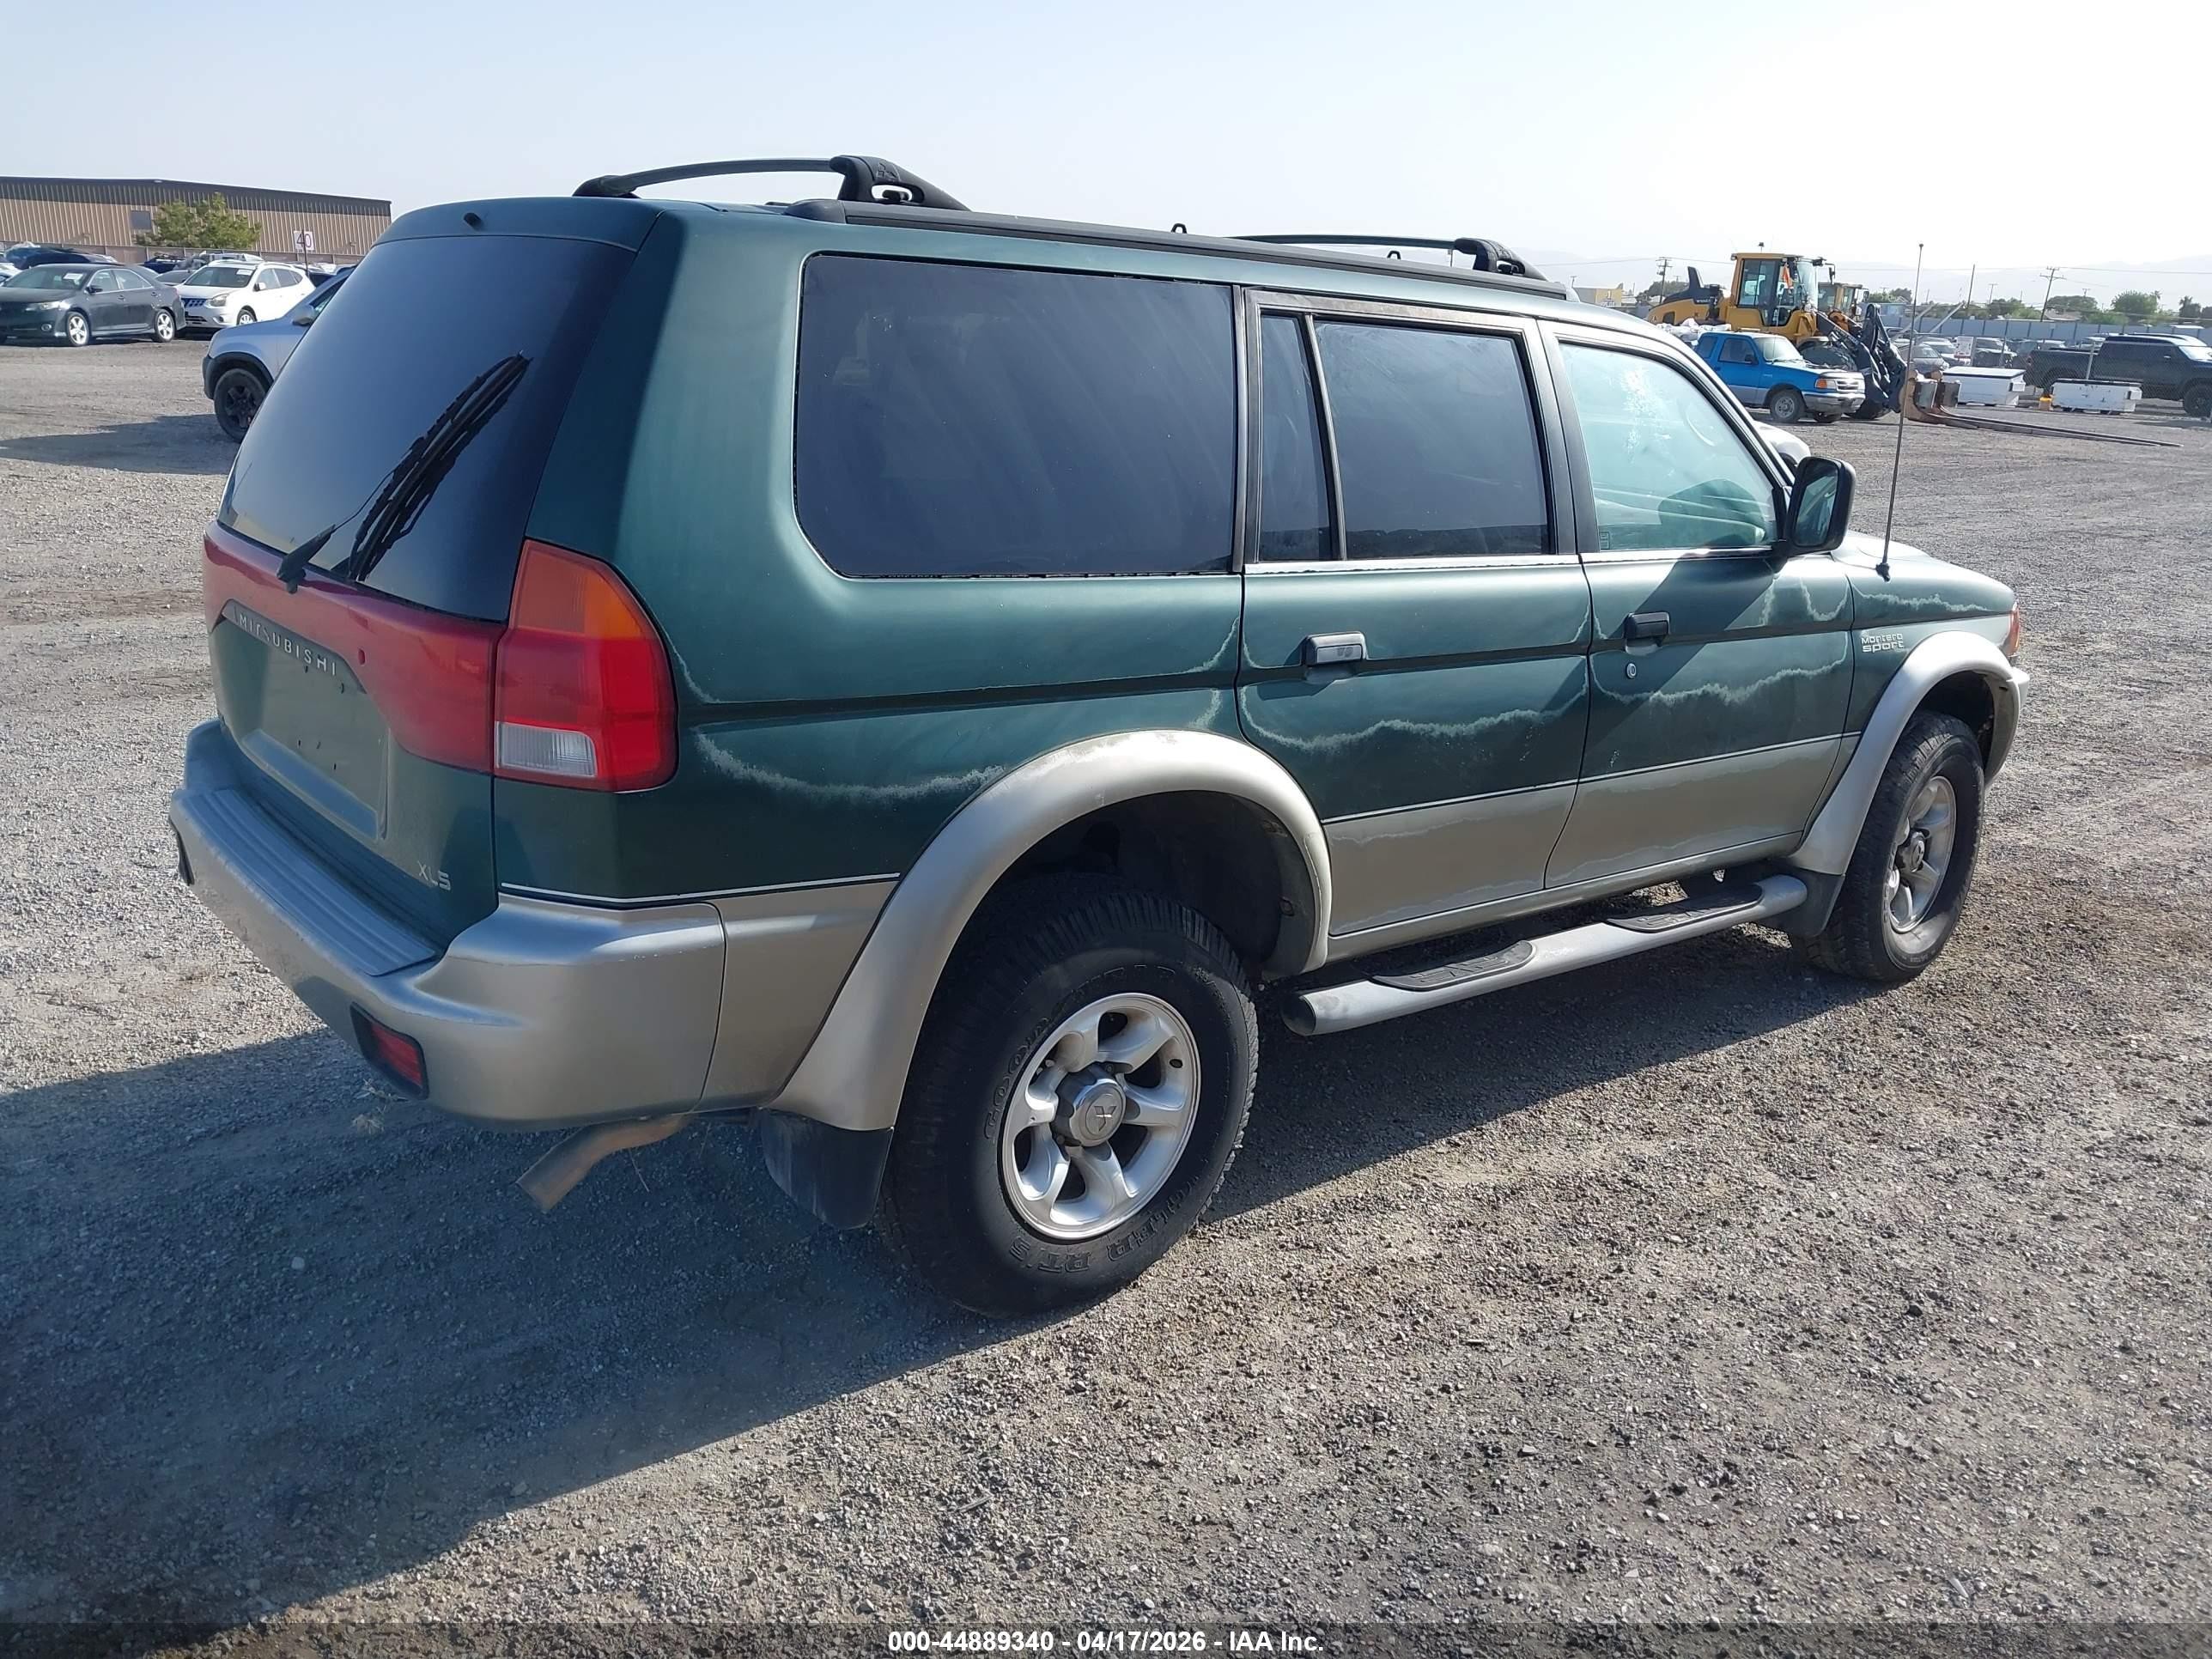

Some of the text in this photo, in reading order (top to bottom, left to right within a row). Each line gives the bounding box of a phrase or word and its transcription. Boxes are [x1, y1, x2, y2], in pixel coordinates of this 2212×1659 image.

[296, 233, 313, 248] 40
[240, 611, 336, 677] MITSUBISHI
[1861, 633, 1903, 644] Montero
[417, 860, 451, 890] XLS
